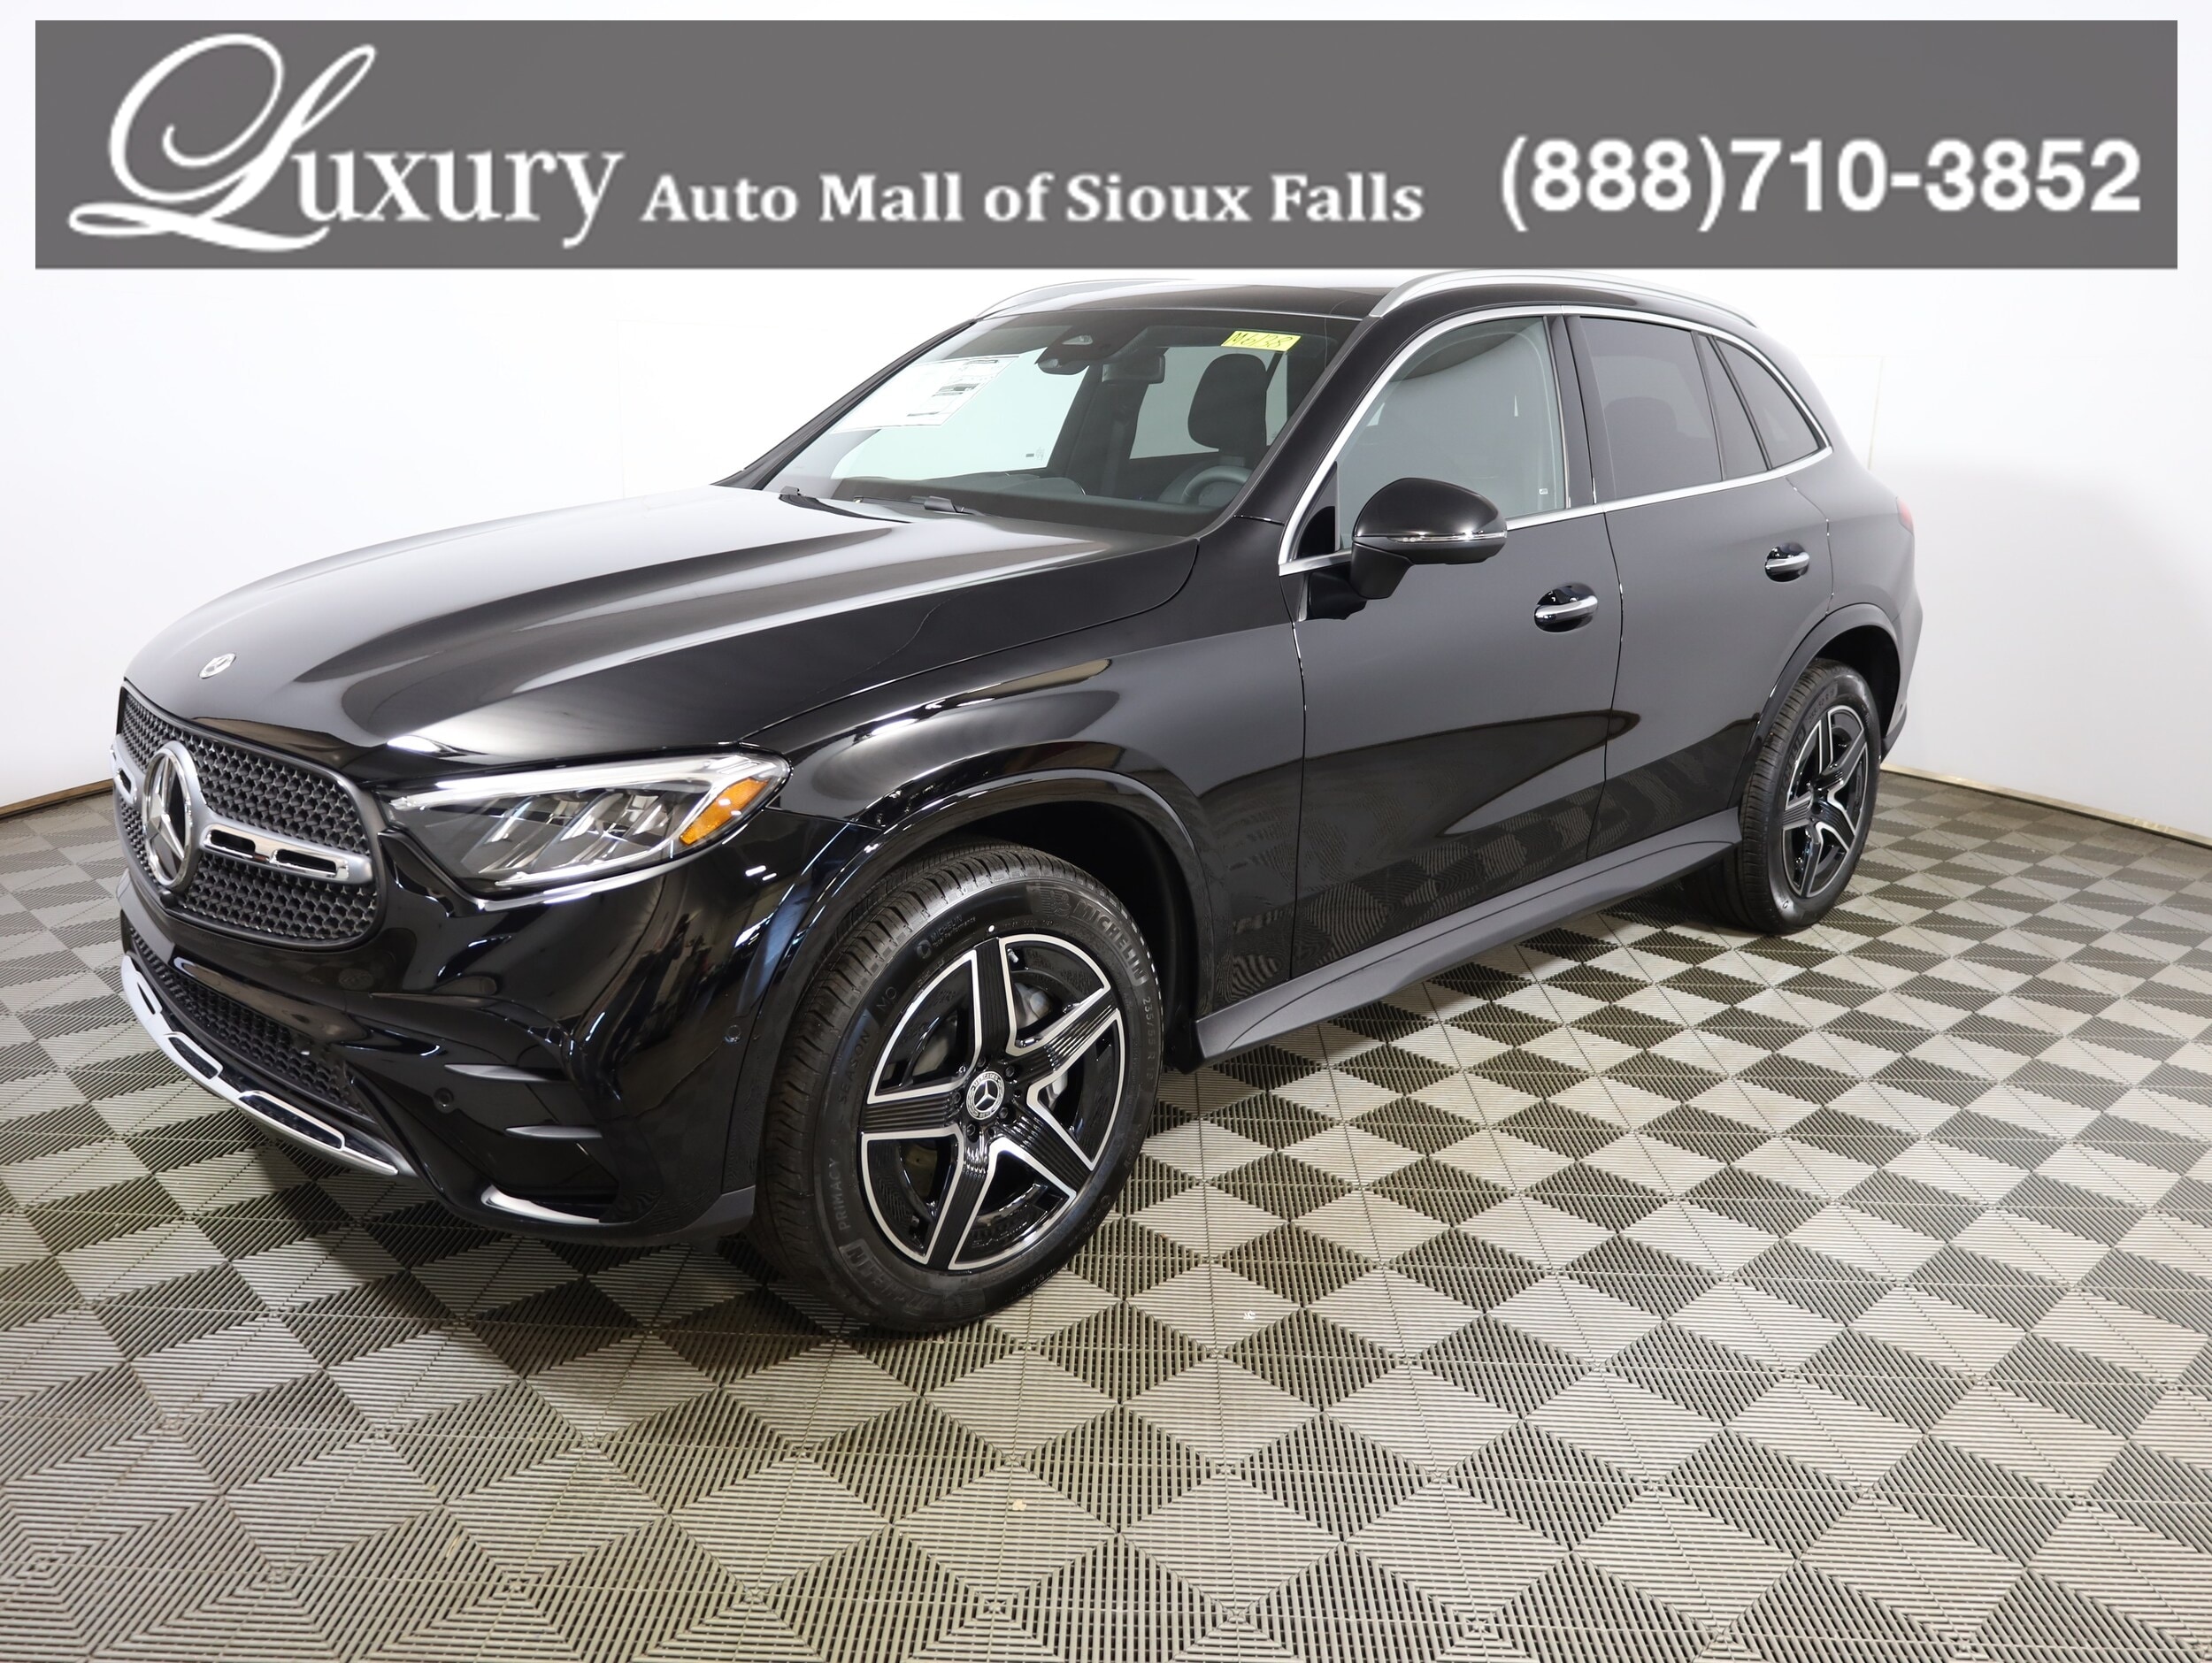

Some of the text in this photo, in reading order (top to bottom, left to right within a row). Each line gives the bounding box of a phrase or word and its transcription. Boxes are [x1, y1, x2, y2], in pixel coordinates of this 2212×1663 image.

[1075, 900, 1145, 983] MICHELIN
[876, 986, 897, 1012] MO
[837, 1030, 871, 1104] SEASON
[828, 1157, 851, 1231] PRIMACY
